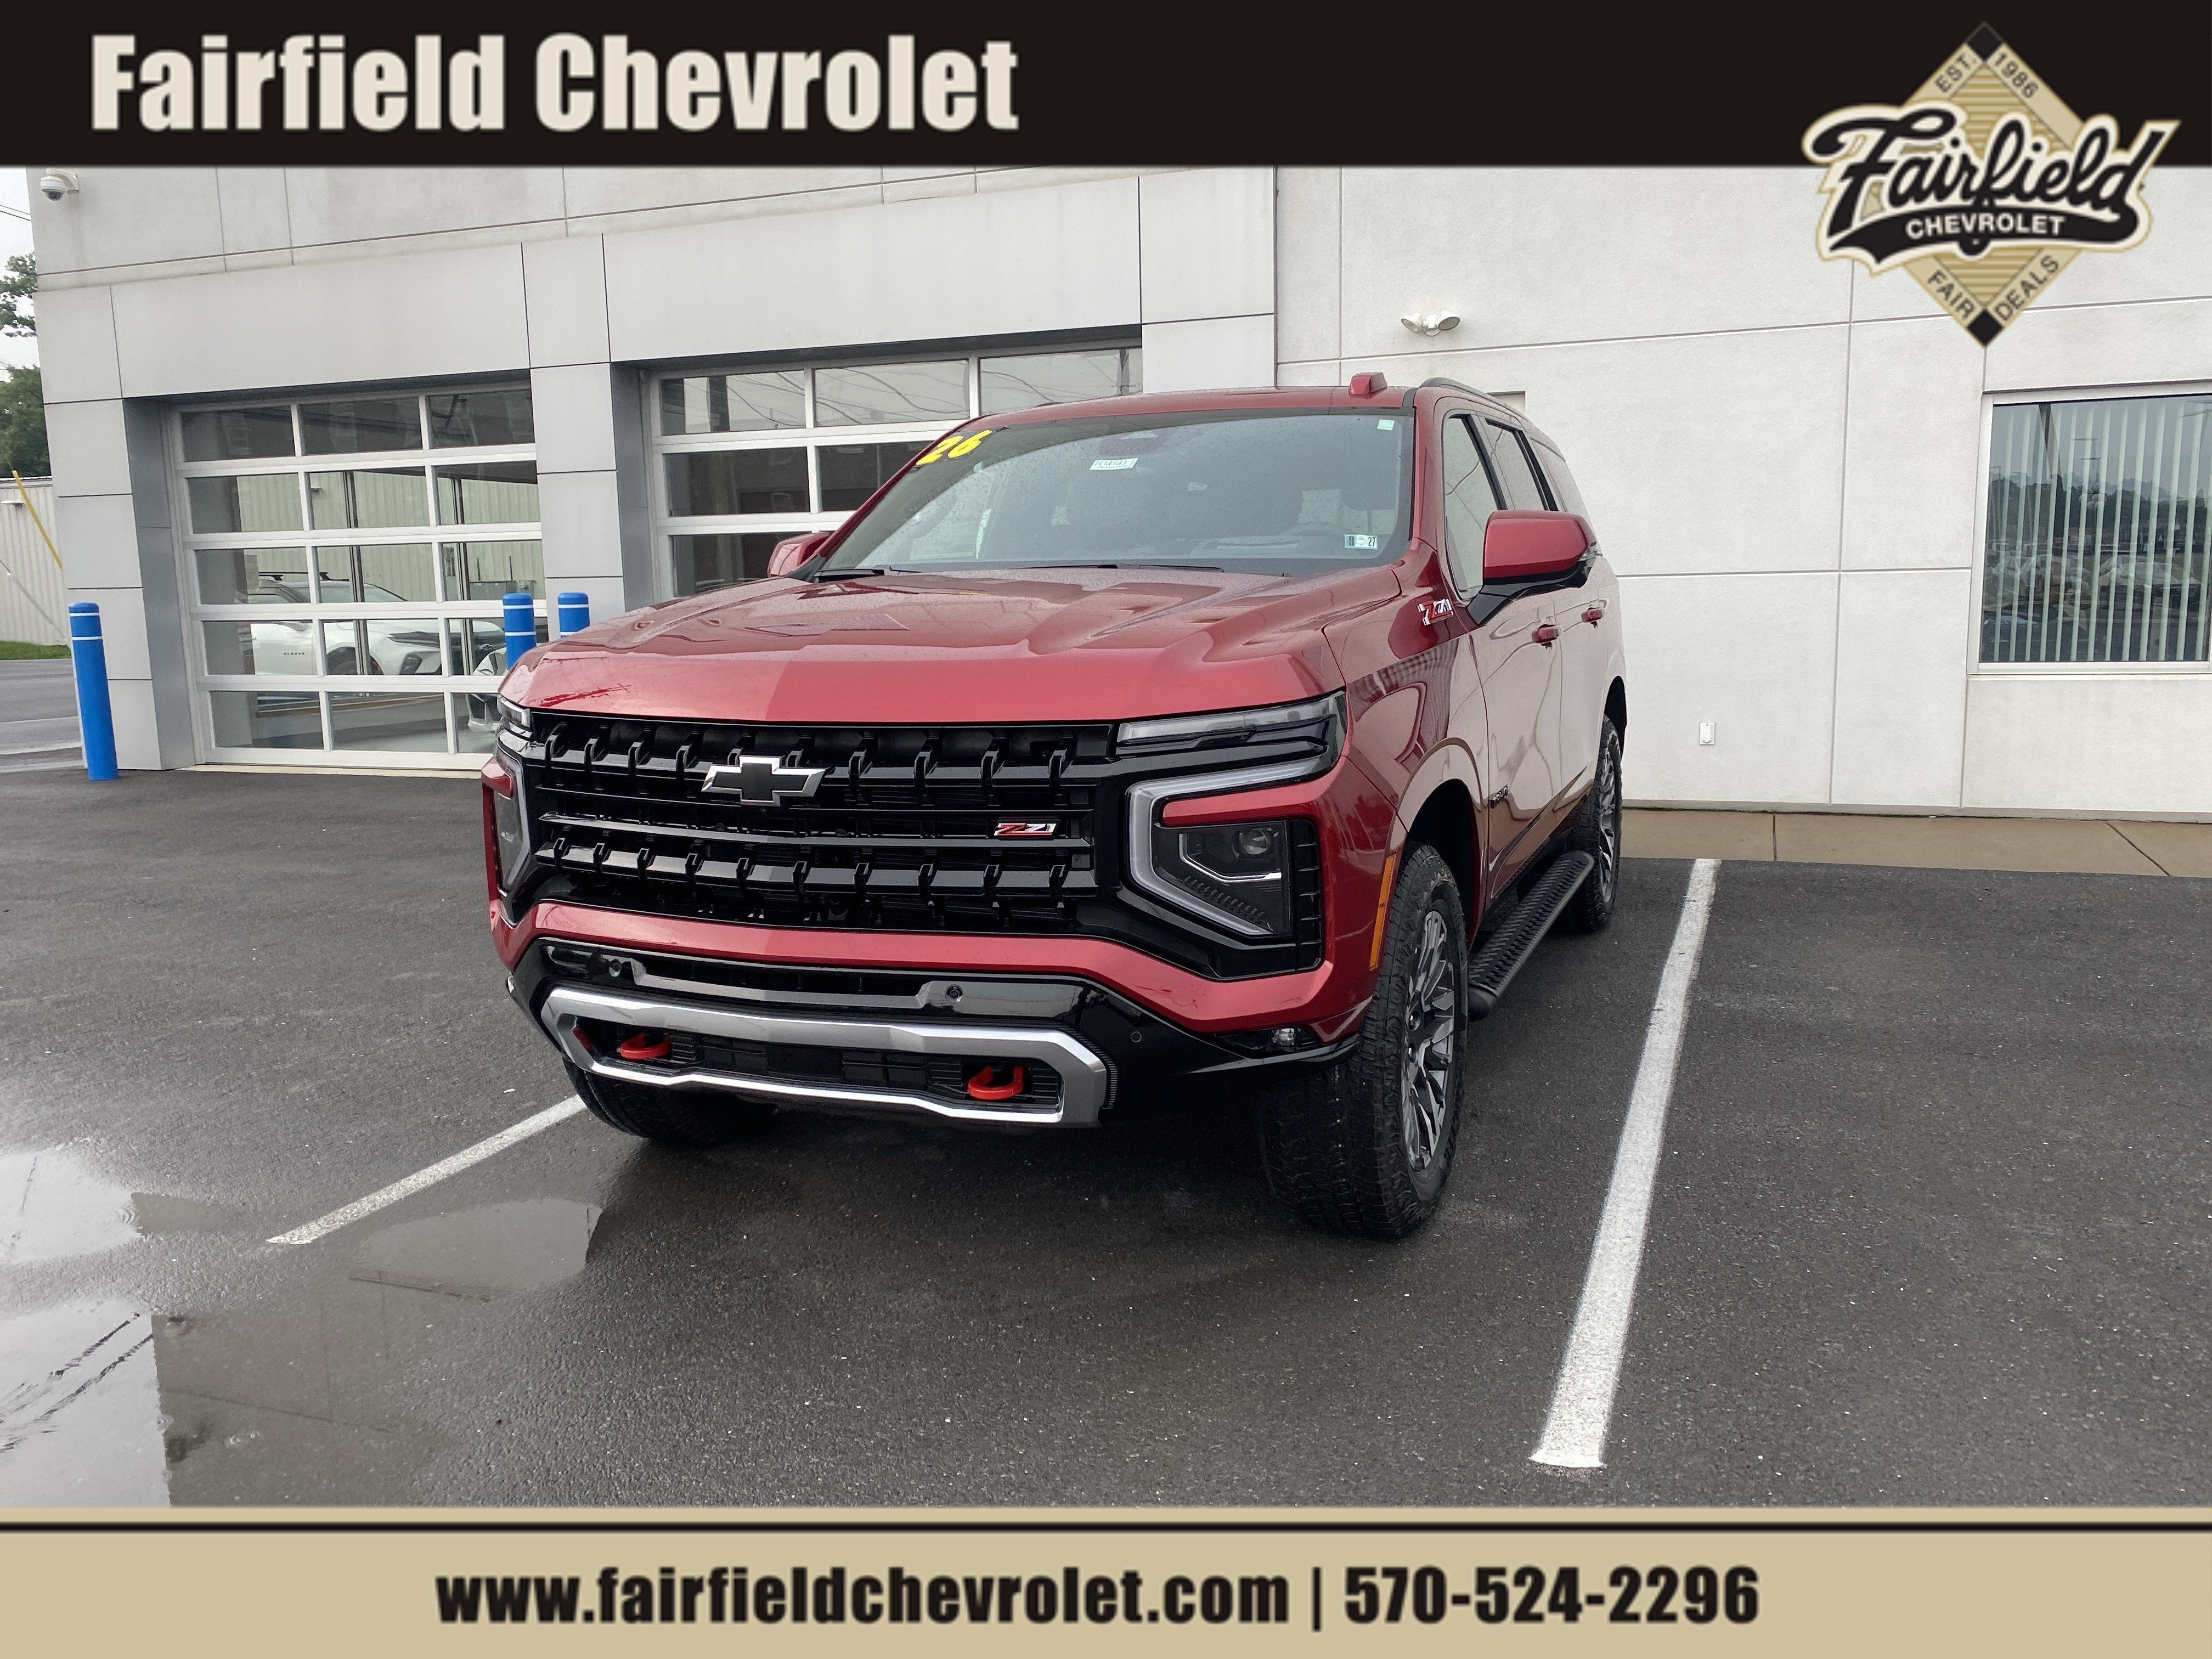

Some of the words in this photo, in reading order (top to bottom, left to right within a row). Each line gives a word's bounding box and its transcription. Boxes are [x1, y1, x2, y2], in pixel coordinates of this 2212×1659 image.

[916, 430, 992, 466] 26
[1368, 537, 1375, 547] 27
[994, 822, 1057, 836] Z71
